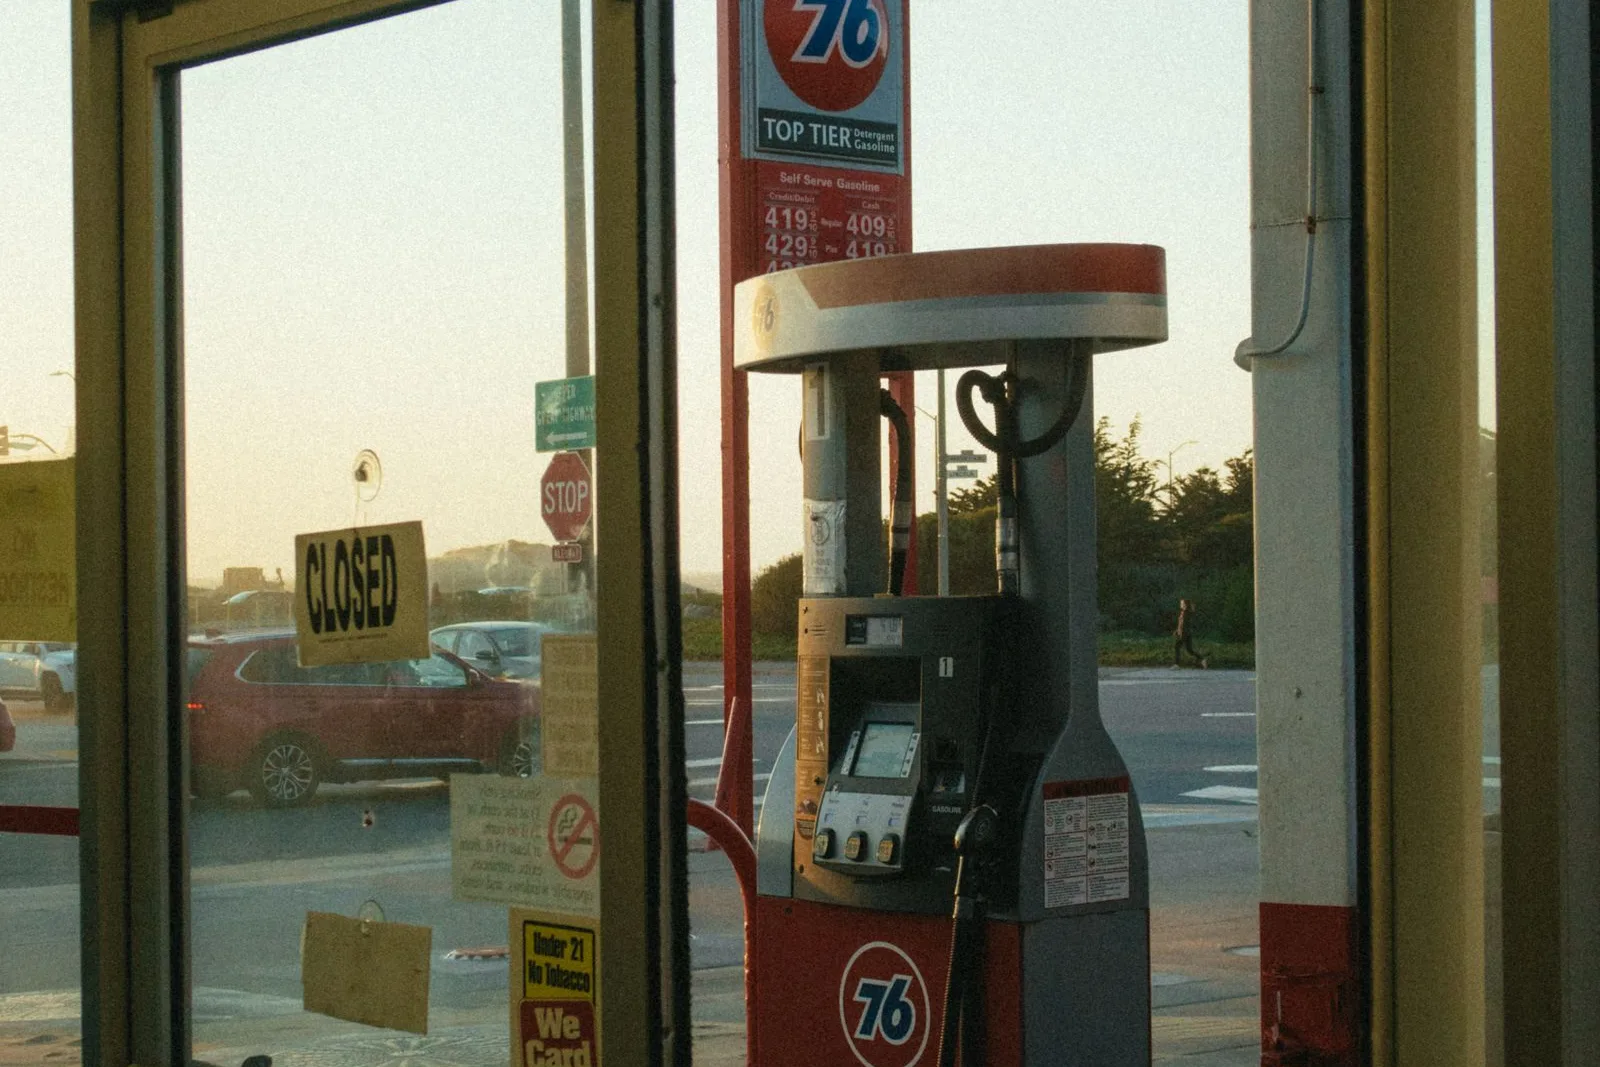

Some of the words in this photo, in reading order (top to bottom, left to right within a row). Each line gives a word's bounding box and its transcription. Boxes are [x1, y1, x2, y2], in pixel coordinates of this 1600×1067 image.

[791, 0, 882, 68] 76
[763, 118, 804, 142] TOP
[809, 123, 852, 148] TIER
[854, 128, 895, 142] Detergent
[854, 140, 895, 154] Gasoline
[780, 172, 801, 184] Self
[804, 174, 833, 188] Serve
[837, 178, 881, 192] Gasoline
[862, 201, 880, 210] Cash
[765, 207, 808, 231] 419
[846, 213, 886, 238] 409
[765, 234, 808, 257] 429
[846, 241, 886, 260] 419
[544, 480, 588, 514] STOP
[306, 534, 398, 635] CLOSED
[932, 806, 961, 814] GASOLINE
[533, 931, 568, 959] Under
[570, 936, 584, 962] 21
[528, 960, 543, 985] No
[545, 962, 591, 993] Tobacco
[852, 973, 914, 1046] 76
[534, 1007, 581, 1040] We
[525, 1039, 591, 1067] Card
